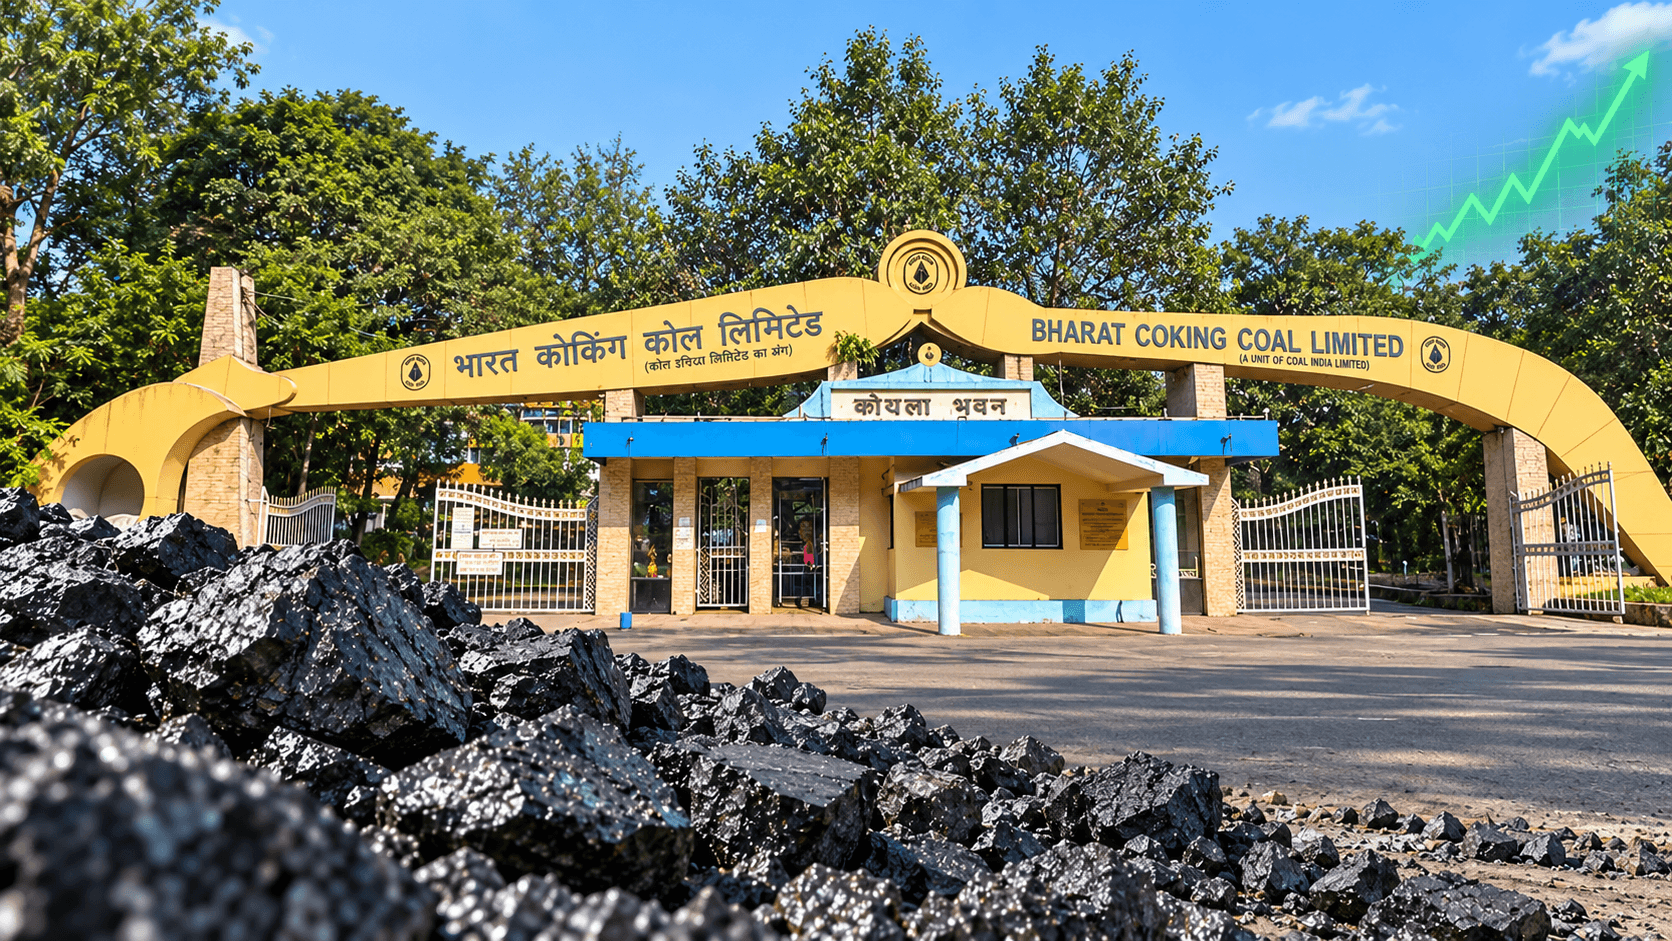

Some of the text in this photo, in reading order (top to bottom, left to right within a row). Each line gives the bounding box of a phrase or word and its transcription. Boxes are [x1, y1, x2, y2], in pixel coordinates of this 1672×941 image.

[453, 304, 823, 378] भारत कोकिंग कोल लिमिटेड
[1031, 317, 1405, 358] BHARAT COKING COAL LIMITED
[752, 348, 767, 359] का
[1239, 353, 1370, 371] (A UNIT OF COAL INDIA LIMITED)
[853, 391, 1008, 417] कोयला भवन
